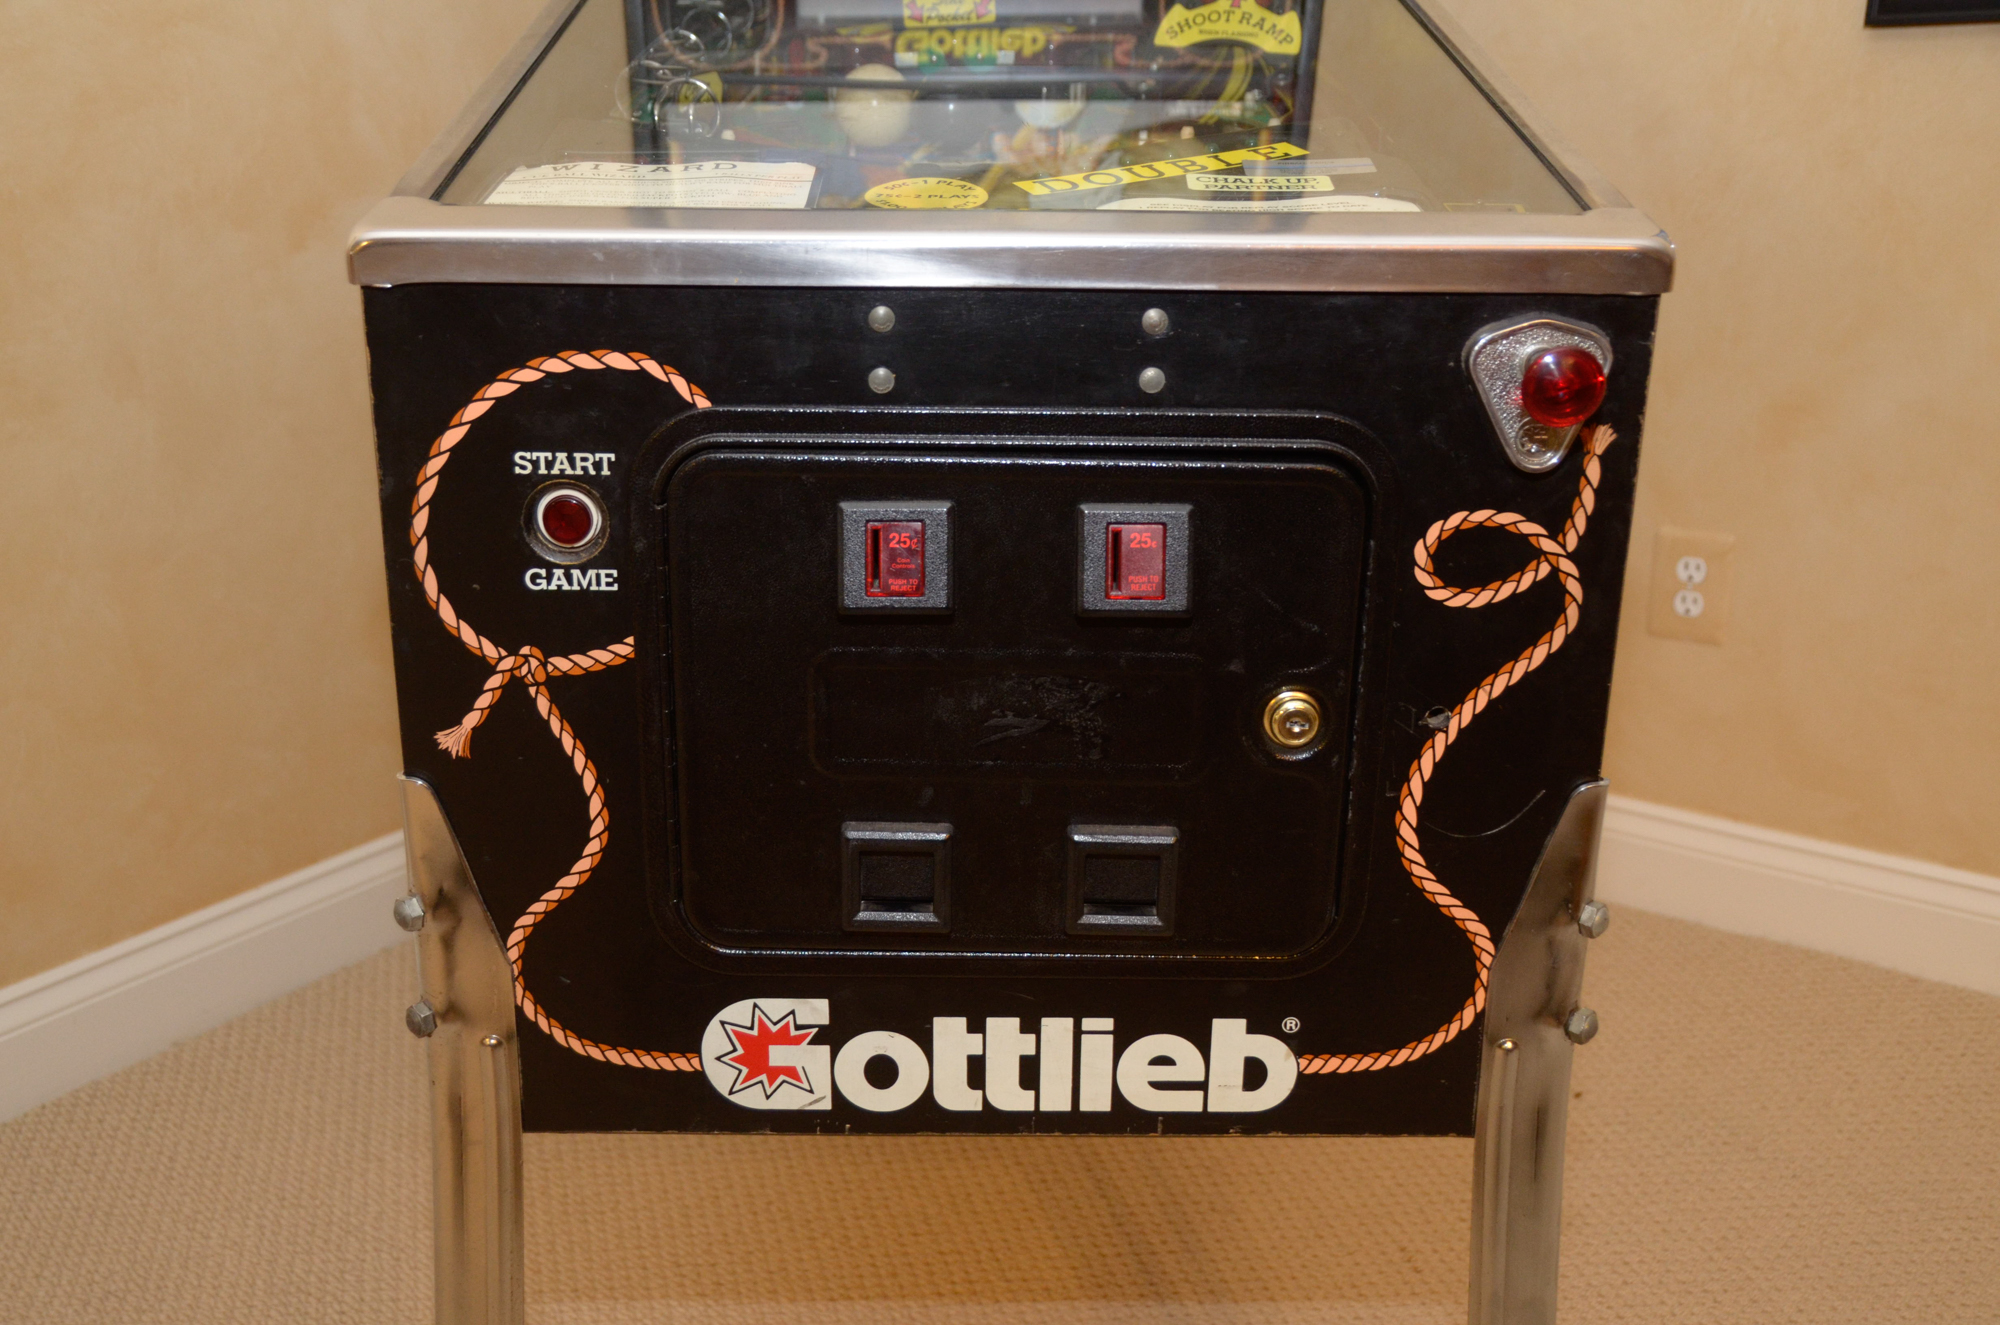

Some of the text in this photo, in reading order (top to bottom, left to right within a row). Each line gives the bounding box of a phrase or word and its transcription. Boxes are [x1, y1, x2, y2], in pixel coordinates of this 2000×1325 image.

[1165, 9, 1295, 45] SHOOT RAMP
[551, 162, 738, 173] WIZARD
[1032, 146, 1293, 194] DOUBLE
[936, 179, 977, 191] PLAY
[1196, 176, 1320, 185] CHALK UP,
[514, 451, 616, 475] START
[889, 532, 918, 549] 25¢
[524, 568, 618, 591] GAME
[1128, 575, 1159, 583] PUSH TO
[1131, 583, 1157, 591] REJECT
[701, 997, 1298, 1113] Gottlieb
